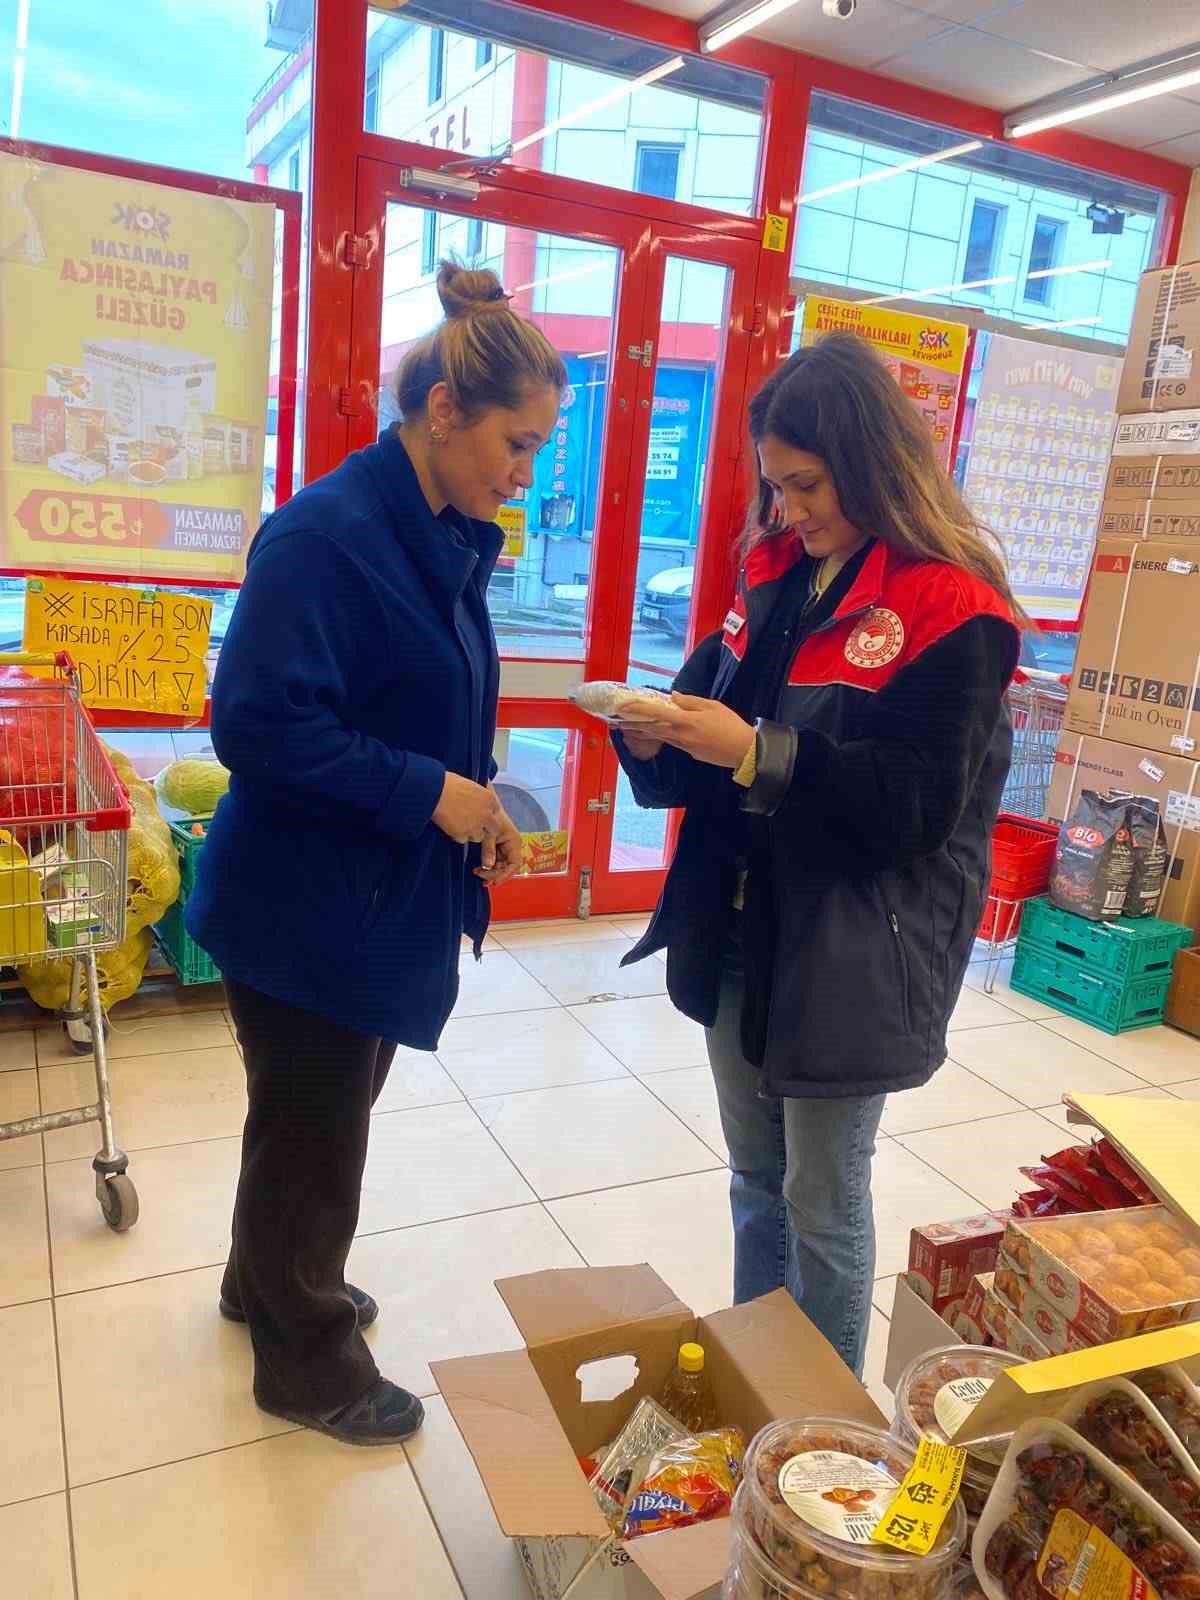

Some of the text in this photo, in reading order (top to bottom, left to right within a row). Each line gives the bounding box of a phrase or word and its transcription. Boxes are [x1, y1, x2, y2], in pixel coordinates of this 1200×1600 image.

[415, 105, 472, 150] TEL
[83, 591, 164, 628] İSRAFA
[1147, 709, 1182, 730] Oven
